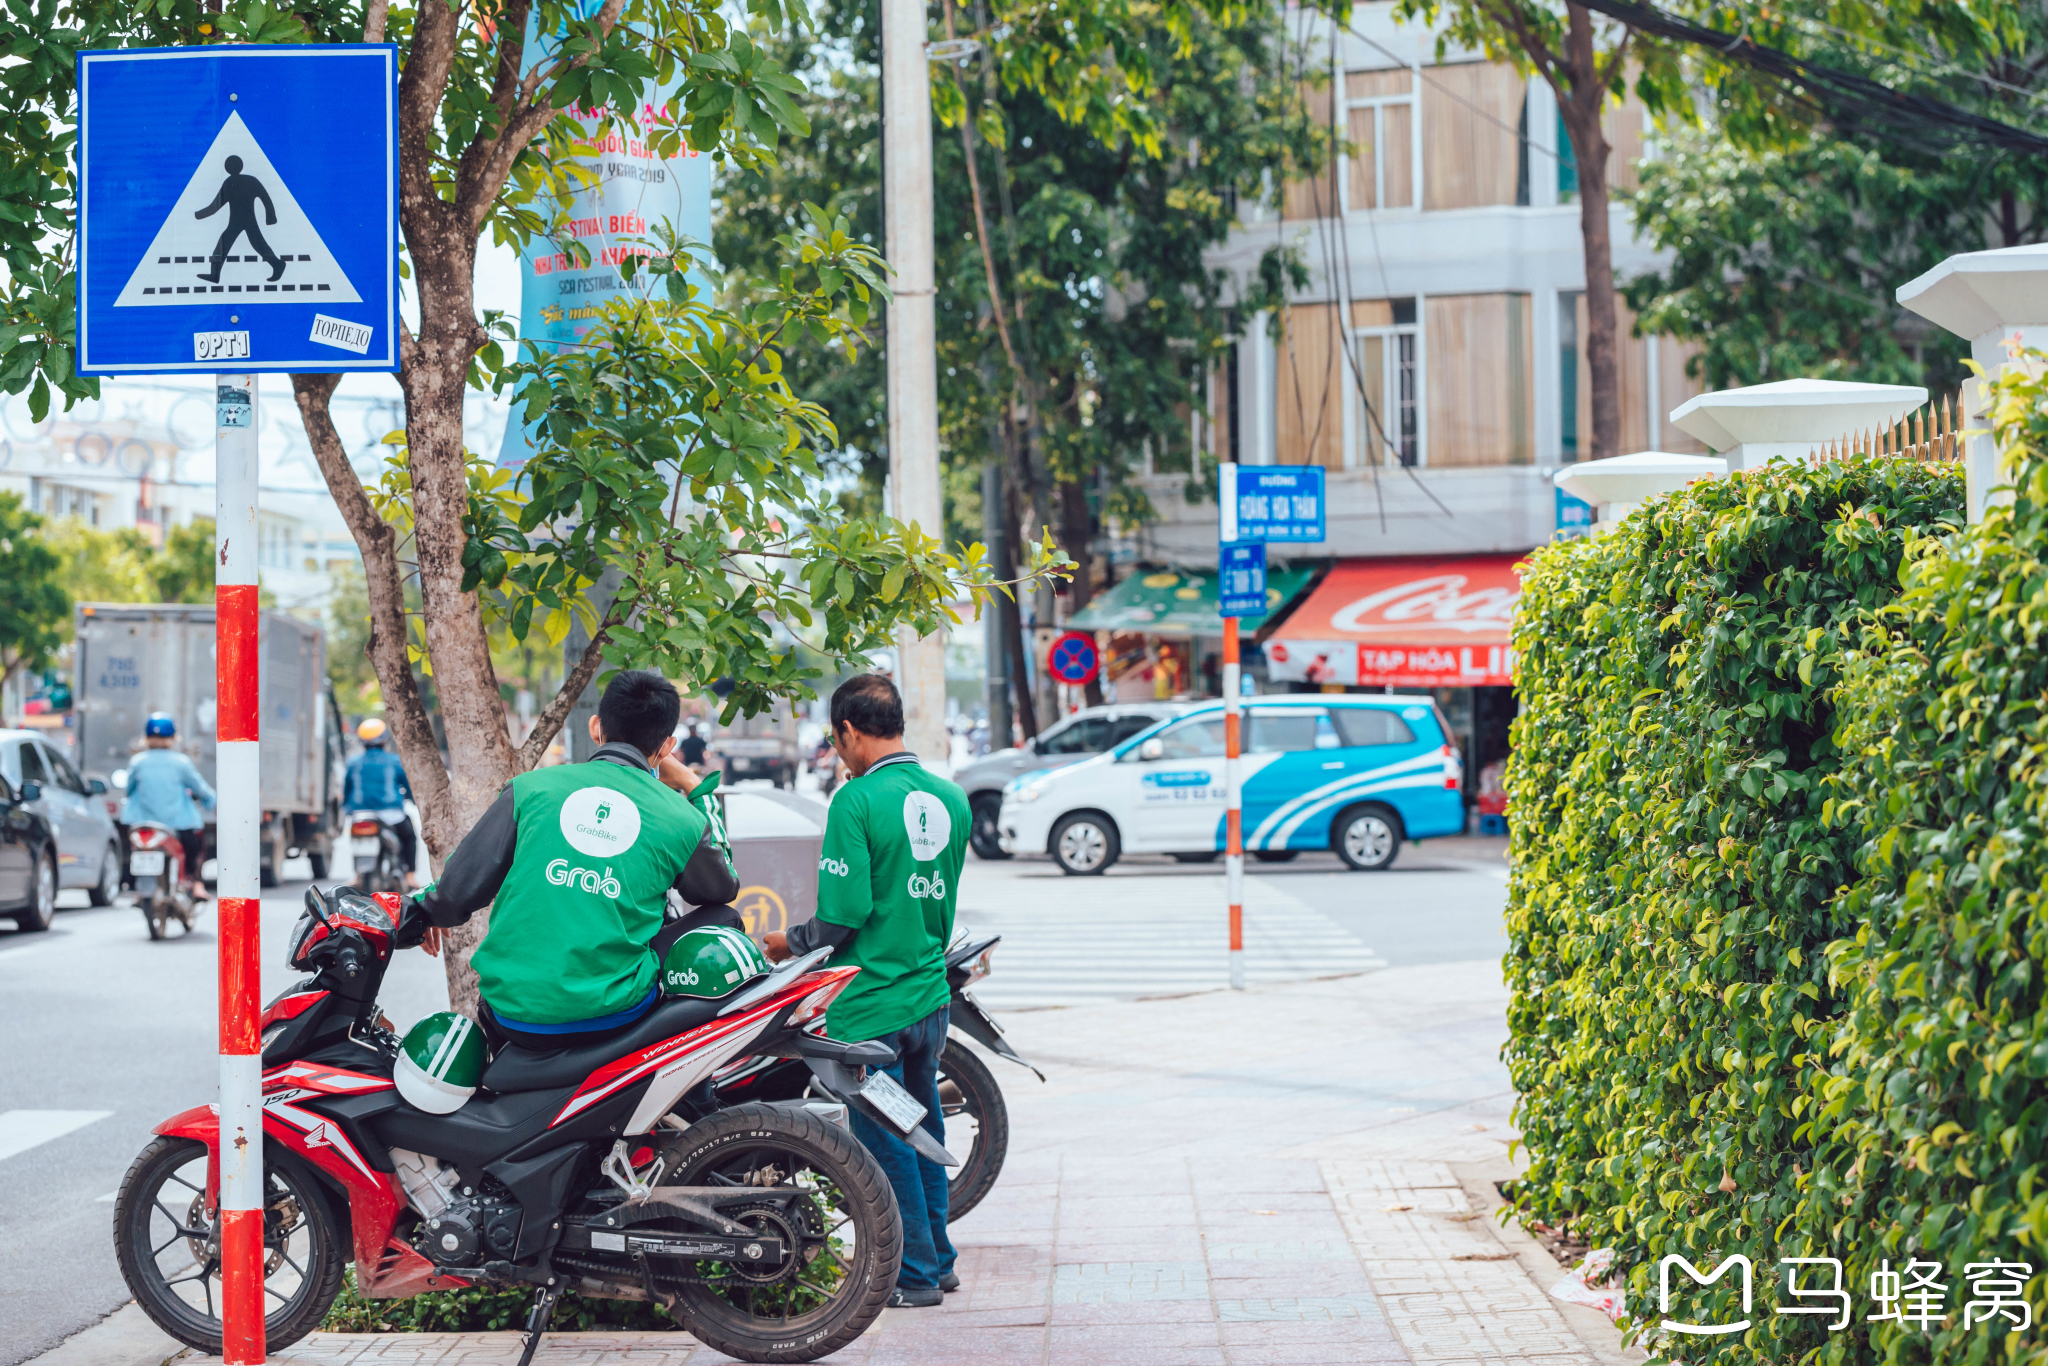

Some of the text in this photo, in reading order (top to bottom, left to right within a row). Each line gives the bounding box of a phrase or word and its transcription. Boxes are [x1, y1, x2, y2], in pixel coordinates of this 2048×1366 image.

[609, 209, 646, 235] BIỂN
[314, 318, 370, 349] ТОРПЕДО
[576, 823, 618, 842] GrabBike
[545, 858, 621, 899] Grab
[667, 967, 699, 985] Grab
[263, 1089, 301, 1107] 150
[306, 1140, 332, 1149] HONDA
[672, 1138, 720, 1178] 120/70-17
